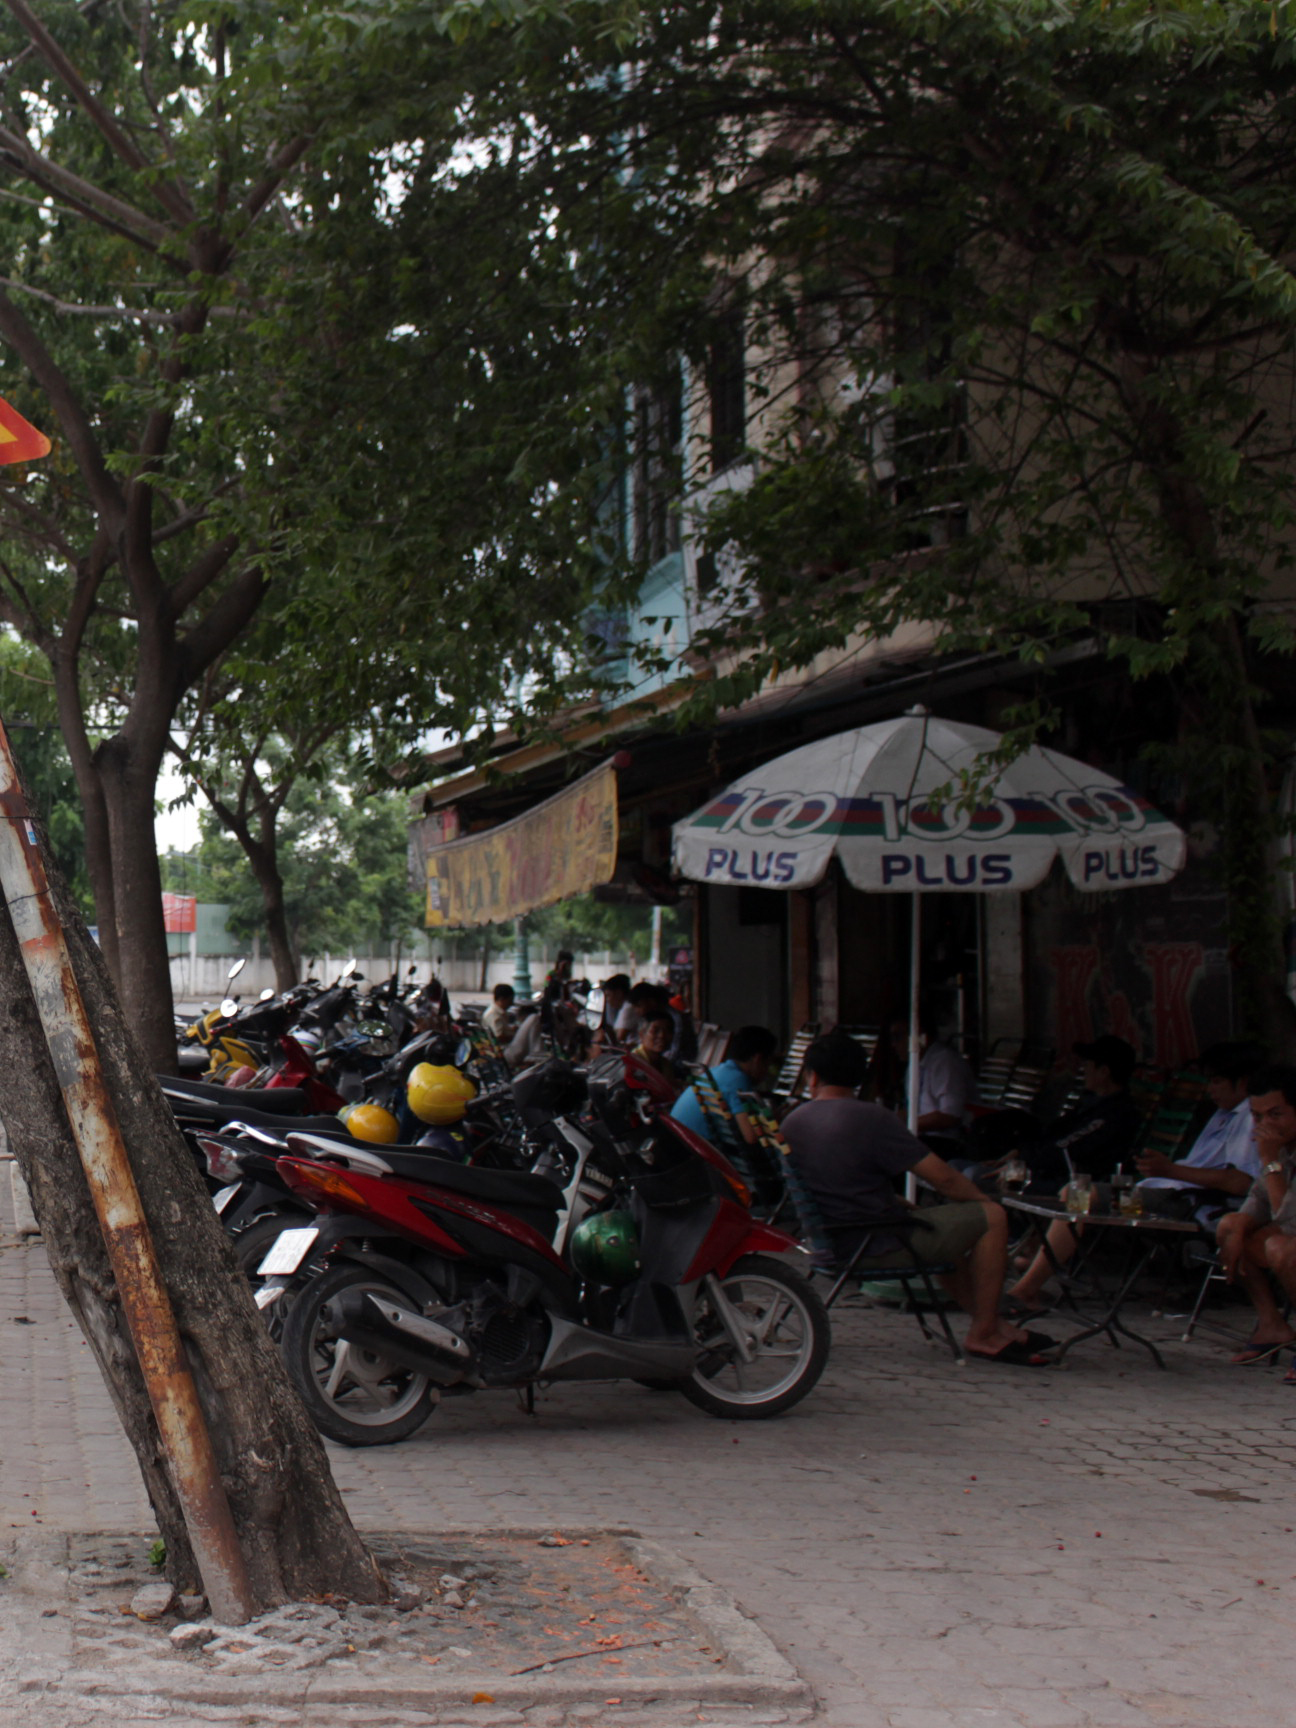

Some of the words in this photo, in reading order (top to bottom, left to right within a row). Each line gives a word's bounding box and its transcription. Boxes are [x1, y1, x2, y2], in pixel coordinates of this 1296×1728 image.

[717, 787, 837, 838] 100
[869, 792, 1016, 842] 100
[1026, 784, 1146, 837] 100
[705, 848, 798, 883] PLUS
[881, 854, 1013, 886] PLUS
[1084, 845, 1159, 883] PLUS
